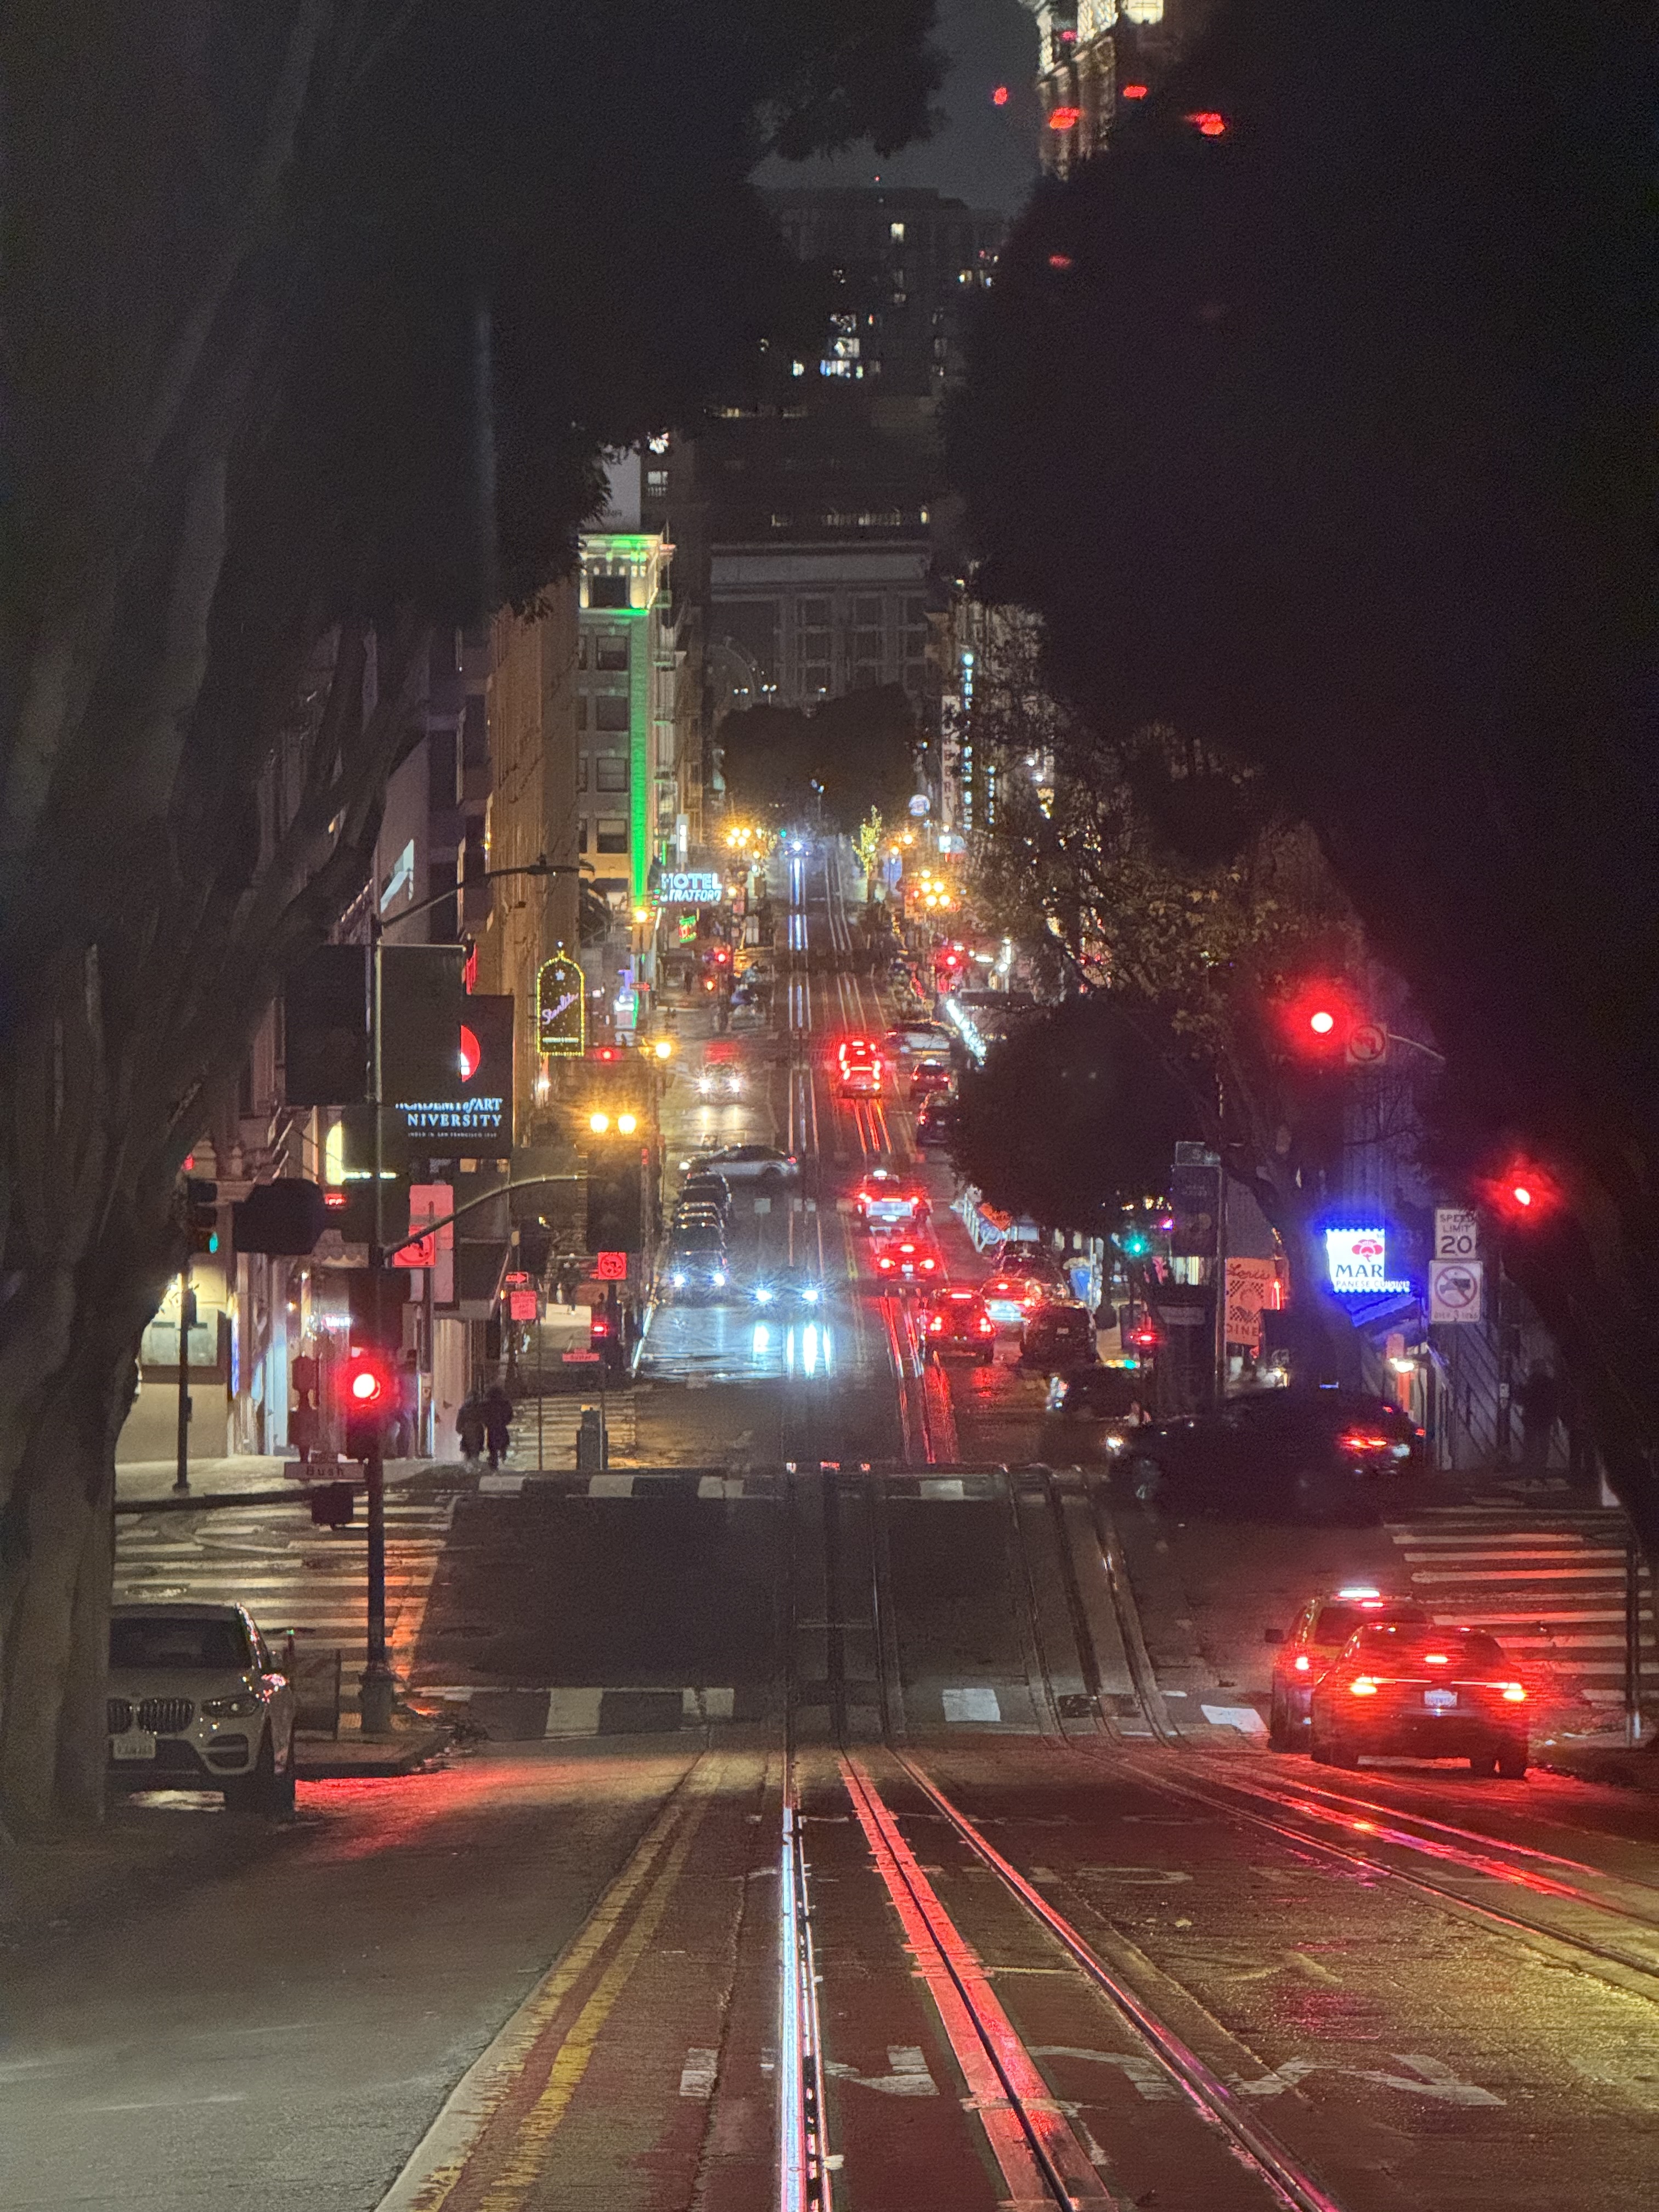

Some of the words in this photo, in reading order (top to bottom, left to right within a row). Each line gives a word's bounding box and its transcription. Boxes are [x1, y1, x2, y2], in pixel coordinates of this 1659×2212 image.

[661, 873, 723, 889] HOTEL
[473, 1098, 504, 1111] ART
[407, 1113, 502, 1127] NIVERSITY
[1440, 1214, 1474, 1223] SPEED
[1442, 1224, 1470, 1233] LIMIT
[1441, 1235, 1472, 1254] 20
[1335, 1264, 1383, 1278] MAR
[1226, 1323, 1259, 1337] DINE
[306, 1465, 344, 1477] Bush
